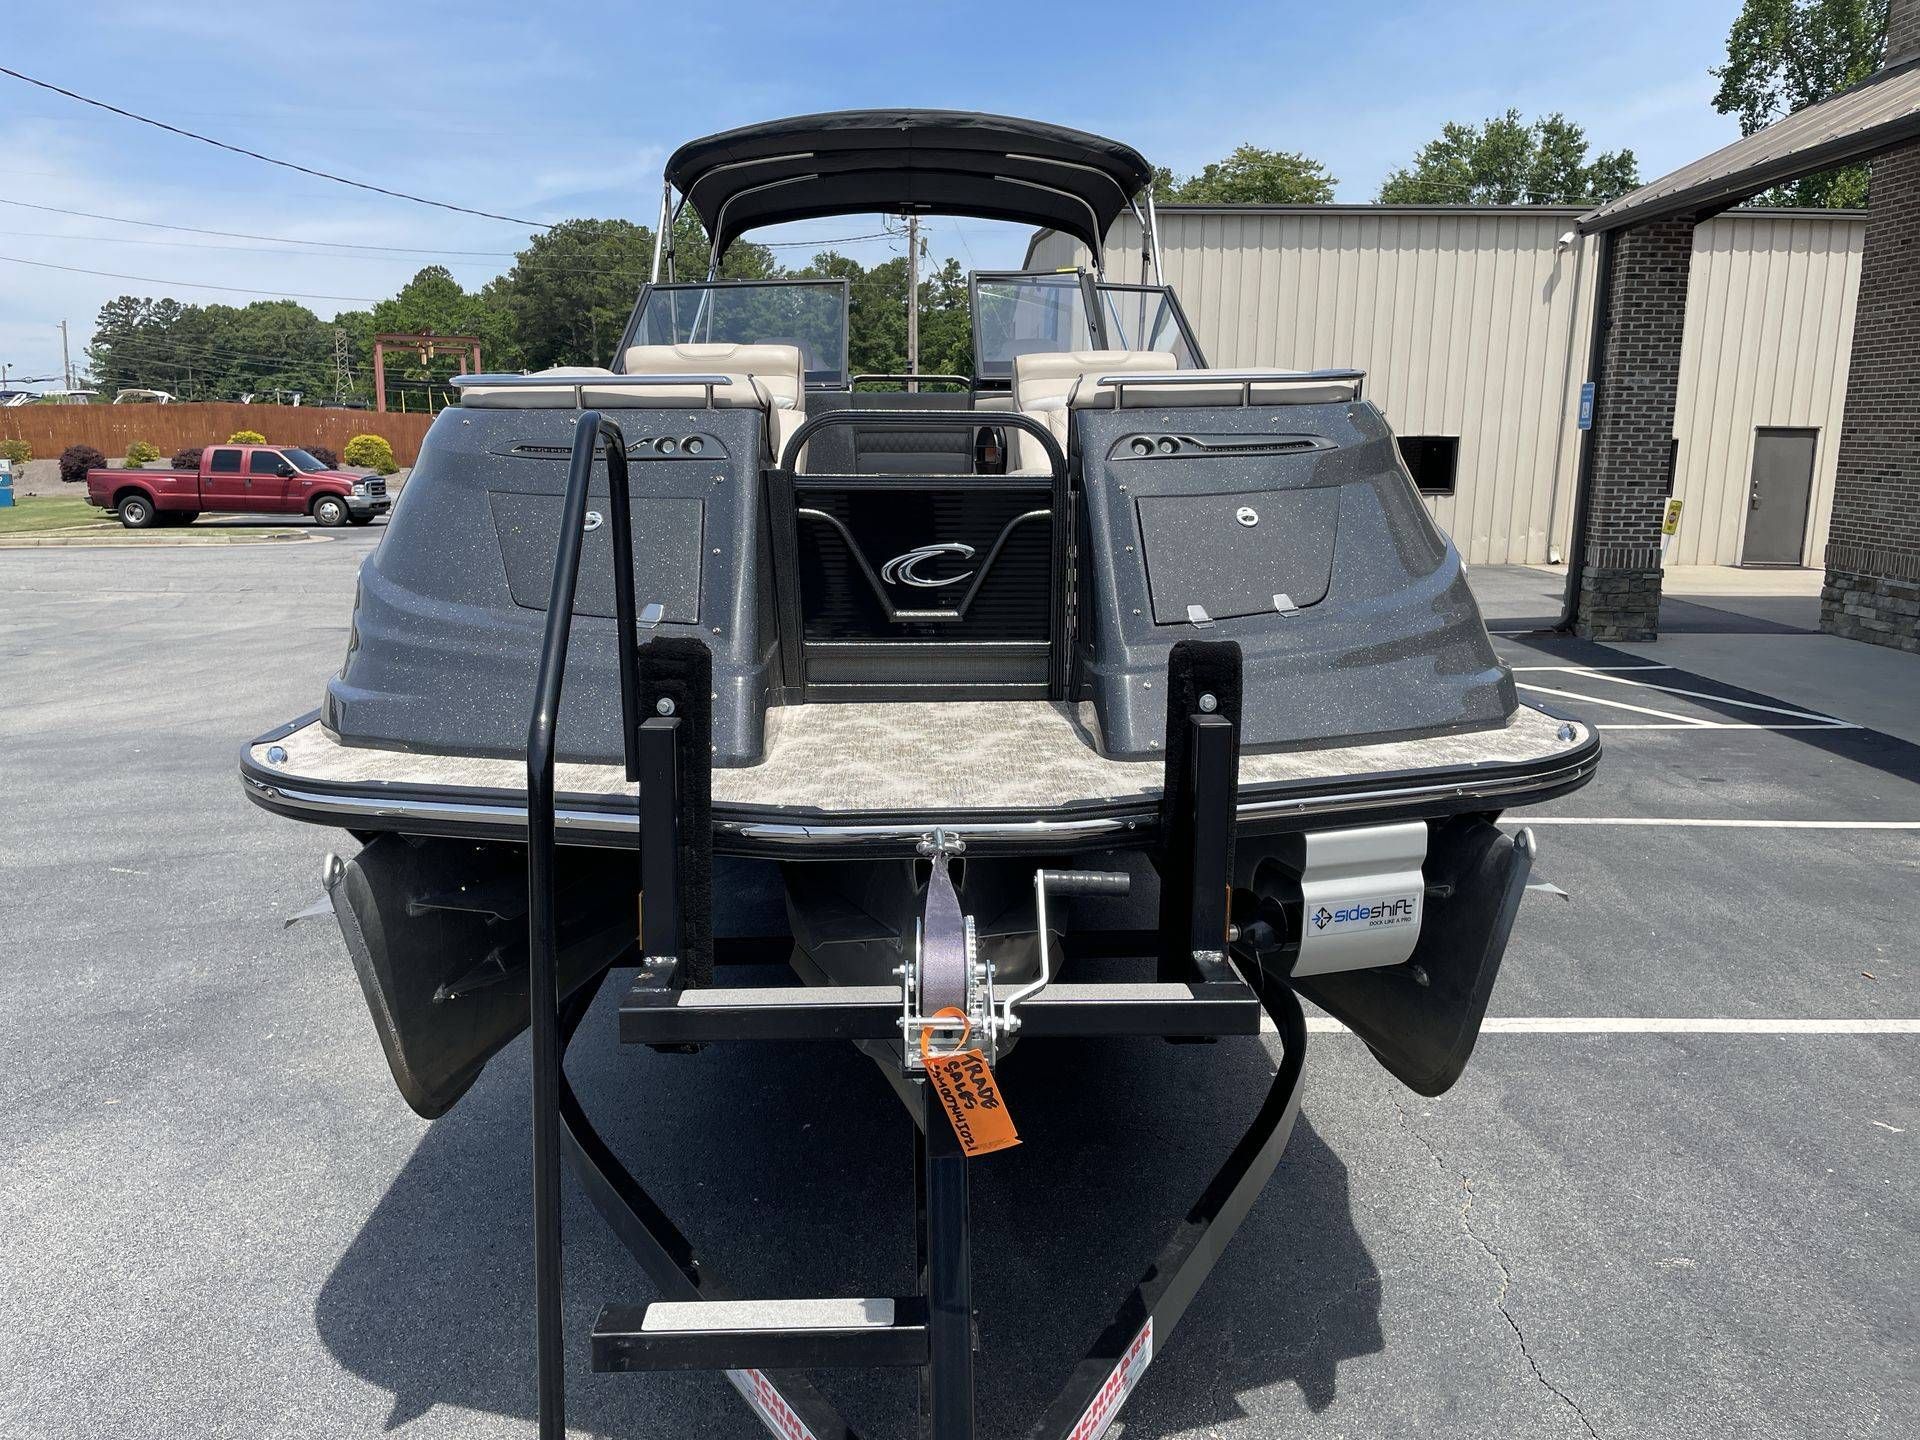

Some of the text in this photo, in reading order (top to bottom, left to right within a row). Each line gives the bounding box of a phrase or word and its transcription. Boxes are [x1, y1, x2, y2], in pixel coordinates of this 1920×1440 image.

[1334, 899, 1413, 923] sideshift
[943, 1060, 978, 1110] SALES
[961, 1054, 999, 1110] TRADE
